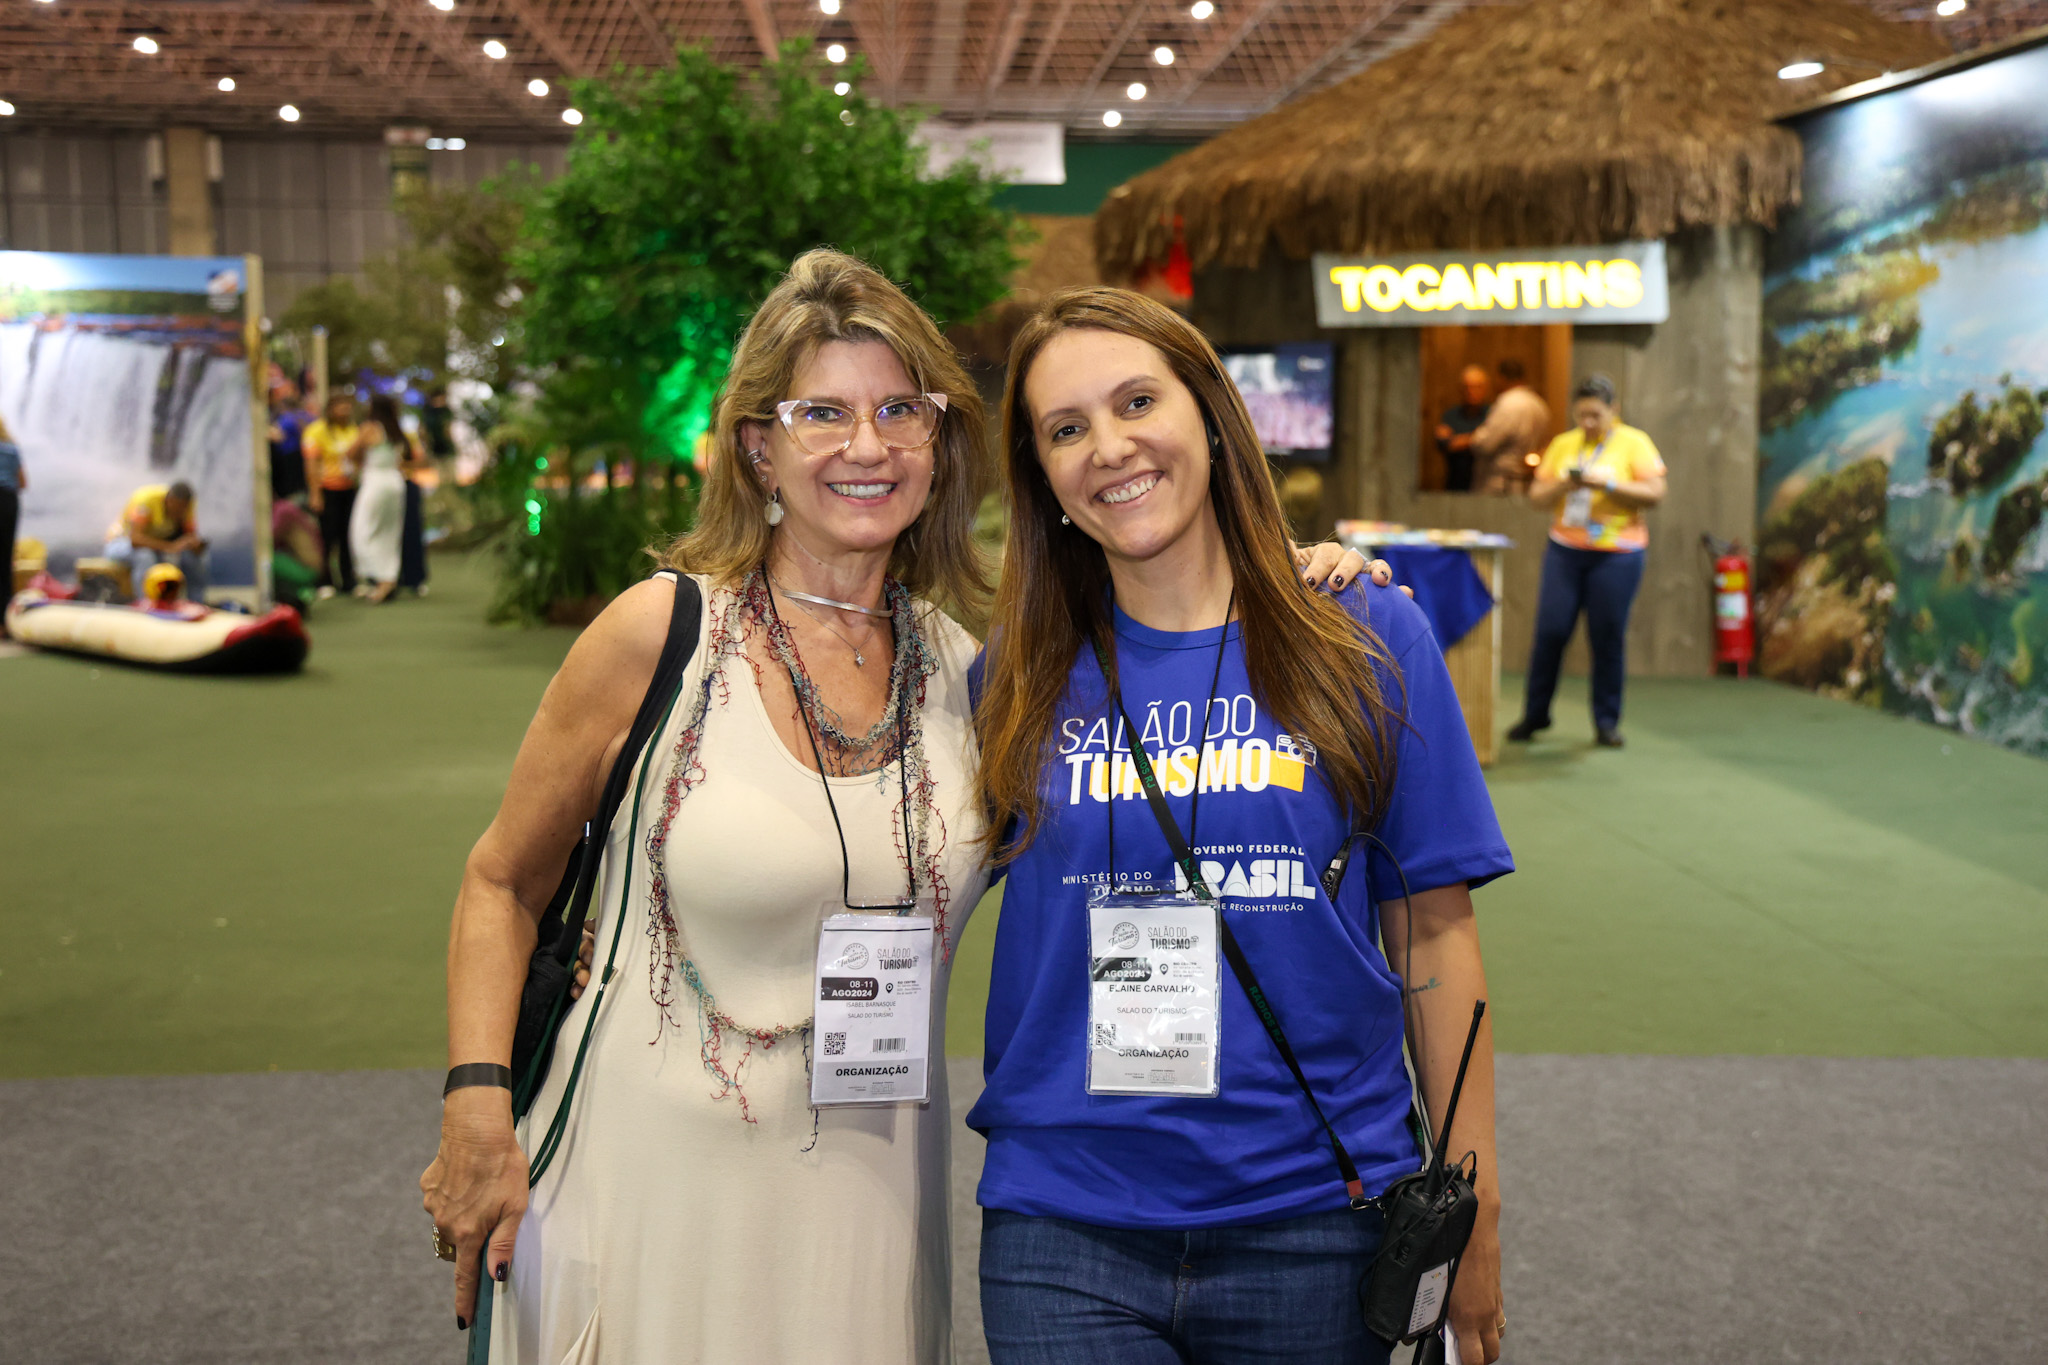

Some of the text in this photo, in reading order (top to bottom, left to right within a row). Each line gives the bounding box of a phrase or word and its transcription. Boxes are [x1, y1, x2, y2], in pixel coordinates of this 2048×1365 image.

[1330, 259, 1644, 312] TOCANTINS
[1058, 694, 1257, 755] SALÃO DO
[1133, 741, 1156, 789] RADIOS RJ
[1188, 844, 1305, 856] OVERNO FEDERAL
[1134, 871, 1152, 880] DO
[1229, 902, 1304, 912] RECONSTRUÇÃO
[1147, 926, 1175, 938] SALÃO
[1176, 927, 1188, 937] DO
[1150, 938, 1191, 949] TURISMO
[877, 947, 901, 959] SALÃO
[902, 948, 911, 958] DO
[879, 958, 912, 970] TURISMO
[1103, 970, 1146, 978] AGO2024
[849, 980, 873, 989] 08-11
[1144, 984, 1196, 993] CARVALHO
[832, 989, 873, 998] AGO2024
[865, 1000, 897, 1008] BARNASQUE
[1118, 1048, 1190, 1060] ORGANIZAÇÃO
[835, 1065, 909, 1077] ORGANIZAÇÃO
